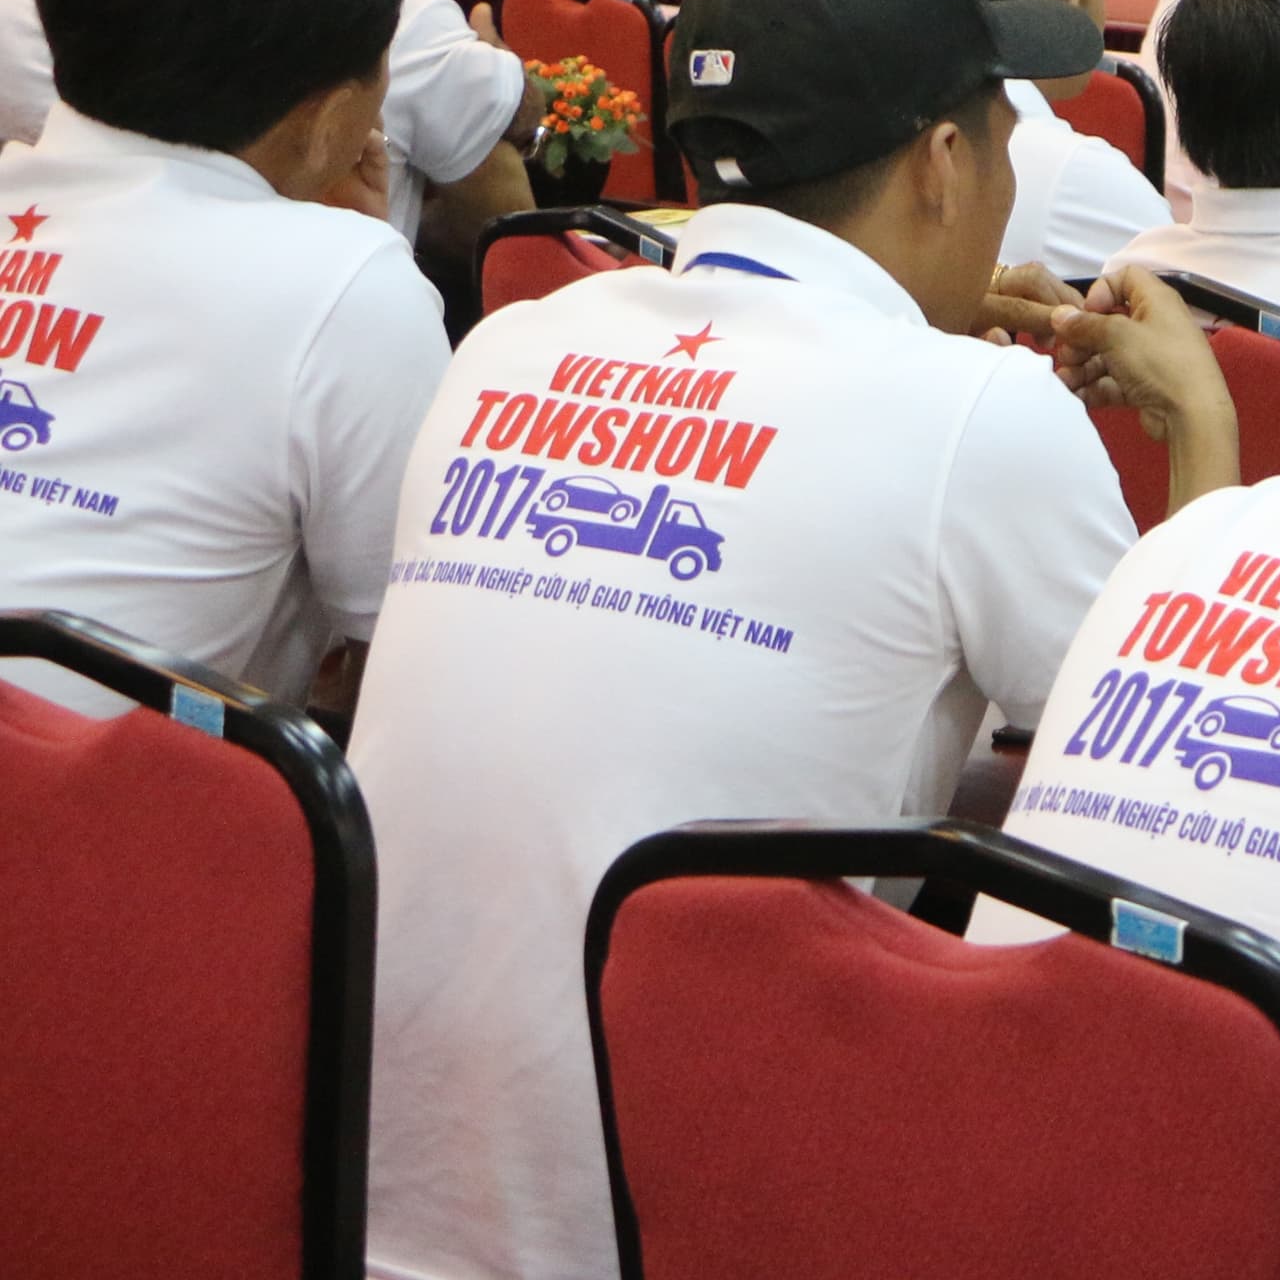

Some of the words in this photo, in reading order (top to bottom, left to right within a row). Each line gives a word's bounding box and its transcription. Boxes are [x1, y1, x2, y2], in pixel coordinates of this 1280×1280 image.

[549, 353, 736, 411] VIETNAM
[460, 389, 778, 490] TOWSHOW
[30, 477, 72, 506] VIỆT
[71, 487, 119, 517] NAM
[430, 457, 546, 540] 2017
[432, 560, 476, 586] DOANH
[475, 567, 533, 599] NGHIỆP
[534, 572, 566, 601] CỨU
[568, 578, 592, 606] HỘ
[591, 586, 632, 613] GIAO
[633, 590, 698, 629] THÔNG
[699, 607, 744, 641] VIỆT
[744, 619, 795, 655] NAM
[1063, 667, 1203, 768] 2017
[1062, 787, 1115, 821] DOANH
[1112, 797, 1178, 840] NGHIỆP
[1178, 809, 1218, 845] CỨU
[1216, 816, 1246, 857] HỘ
